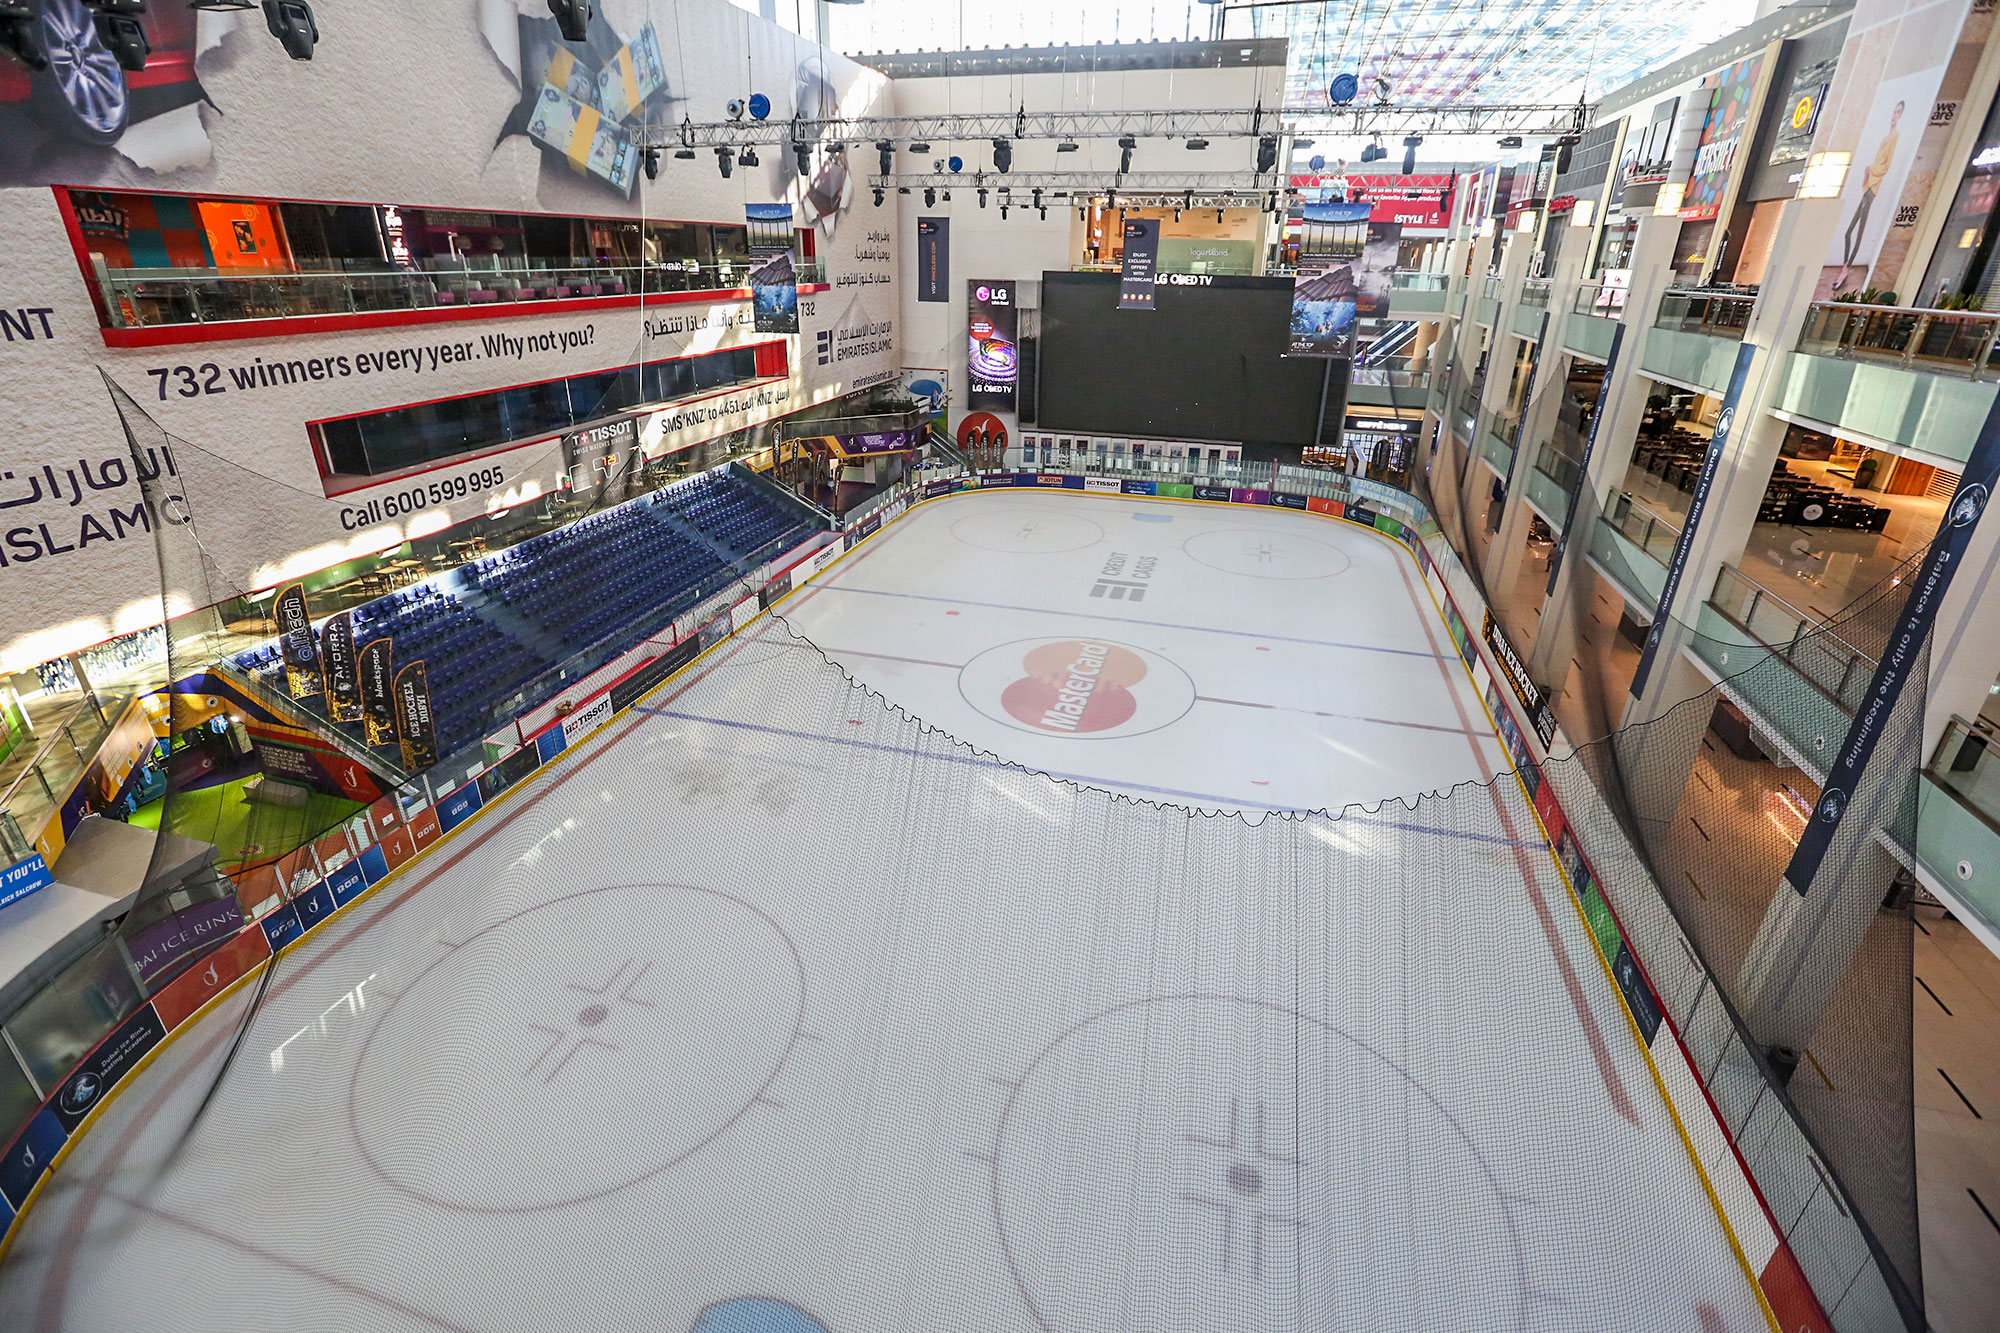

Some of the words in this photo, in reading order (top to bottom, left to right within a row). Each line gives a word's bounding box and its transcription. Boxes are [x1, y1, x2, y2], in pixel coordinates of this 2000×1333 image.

[1931, 110, 1954, 121] are
[1937, 103, 1957, 113] we
[1896, 212, 1917, 223] are
[1901, 206, 1919, 215] we
[1153, 273, 1168, 286] LG
[1199, 276, 1213, 286] TV
[991, 288, 1007, 300] LG
[147, 363, 226, 401] 732
[228, 354, 351, 390] winners
[355, 347, 423, 374] every
[426, 340, 481, 372] year.
[481, 332, 524, 360] Why
[528, 330, 558, 352] not
[559, 324, 595, 355] you?
[837, 342, 868, 361] EMIRATES
[869, 338, 892, 354] ISLAMIC
[972, 384, 982, 393] LG
[661, 414, 682, 434] SMS
[708, 407, 718, 420] to
[718, 400, 740, 418] 4451
[588, 420, 632, 443] TISSOT
[1704, 447, 1719, 482] Dubai
[340, 499, 382, 531] Call
[383, 487, 427, 518] 600
[429, 475, 468, 505] 599
[469, 465, 505, 493] 995
[1096, 480, 1120, 488] TISSOT
[1697, 482, 1707, 499] Ice
[1690, 501, 1702, 525] Rink
[1676, 527, 1693, 567] Skating
[1101, 552, 1128, 576] CREDIT
[1132, 555, 1158, 579] CARDS
[1661, 567, 1680, 614] Academy
[1915, 550, 1950, 614] Balance
[283, 597, 313, 662] alltech
[1907, 616, 1921, 630] is
[328, 622, 346, 680] AFORRA
[1891, 633, 1911, 668] only
[1492, 624, 1508, 658] DUBAI
[1514, 658, 1539, 707] HOCKEY
[1041, 643, 1111, 732] MasterCard
[1880, 670, 1896, 696] the
[403, 681, 418, 720] HOCKEY
[417, 694, 430, 723] DUBAI
[577, 698, 609, 726] TISSOT
[1845, 697, 1885, 770] beginning
[6, 858, 45, 884] YOU'LL
[15, 880, 42, 898] SALCHOW
[161, 930, 190, 953] ICE
[193, 908, 240, 936] RINK
[100, 1053, 125, 1078] Skating
[123, 1027, 153, 1057] Academy
[101, 1046, 119, 1068] Dubai
[118, 1038, 130, 1052] Ice
[130, 1024, 145, 1043] Rink
